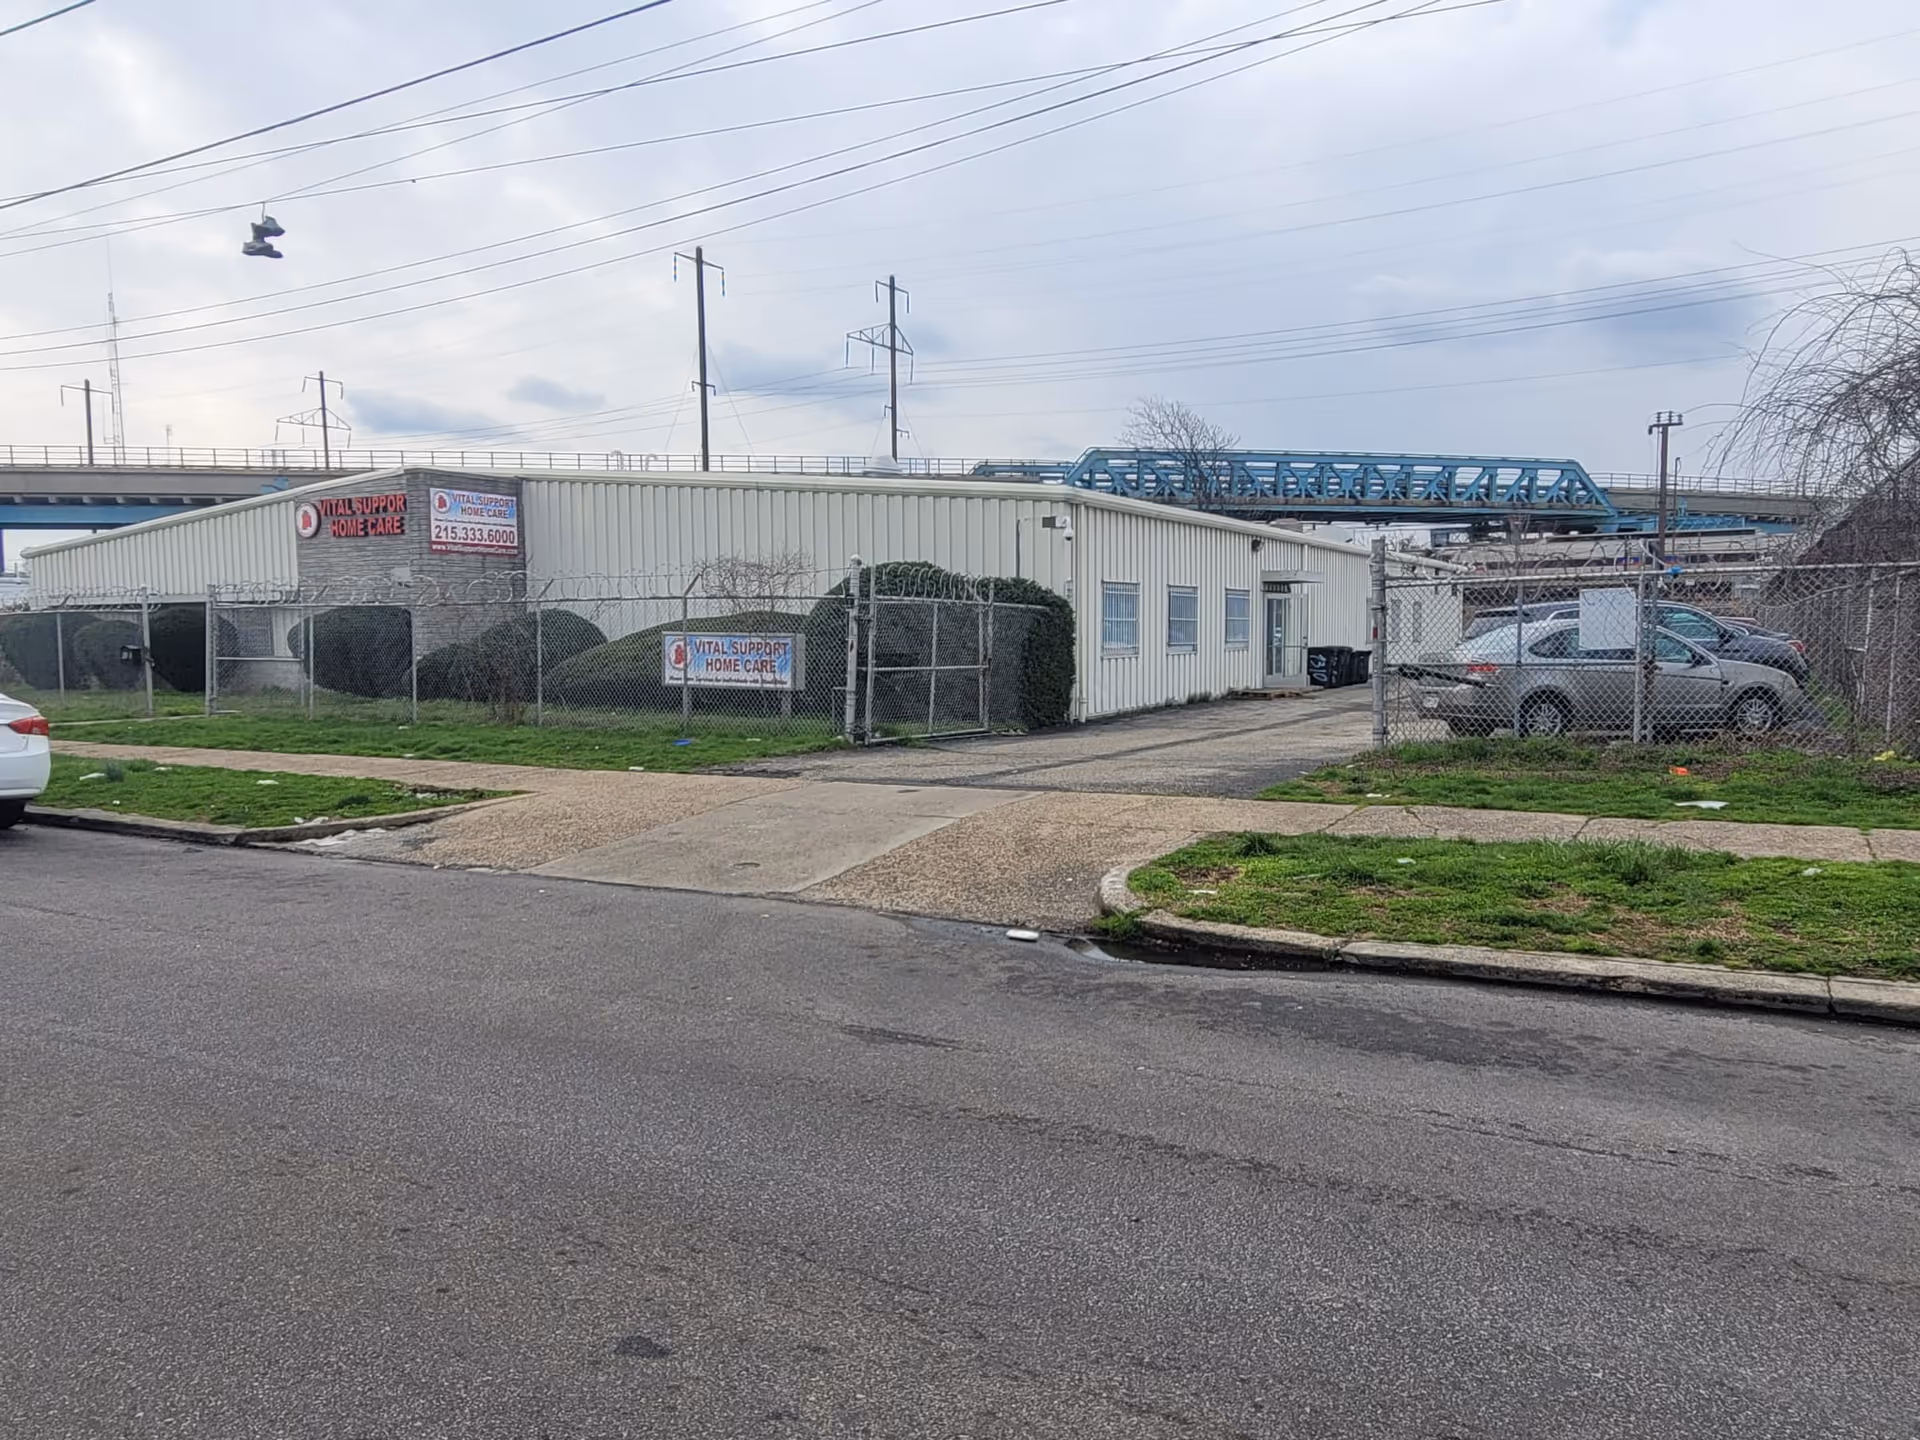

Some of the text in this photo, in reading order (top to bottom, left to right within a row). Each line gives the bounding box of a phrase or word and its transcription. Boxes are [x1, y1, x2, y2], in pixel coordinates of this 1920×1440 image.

[319, 494, 408, 516] VITAL SUPPOR
[452, 493, 515, 508] VITAL SUPPORT
[461, 506, 509, 519] HOME CARE
[330, 516, 402, 537] HOME CARE
[434, 525, 515, 544] 215.333.6000
[694, 640, 789, 658] VITAL SUPPORT
[706, 658, 777, 673] HOME CARE
